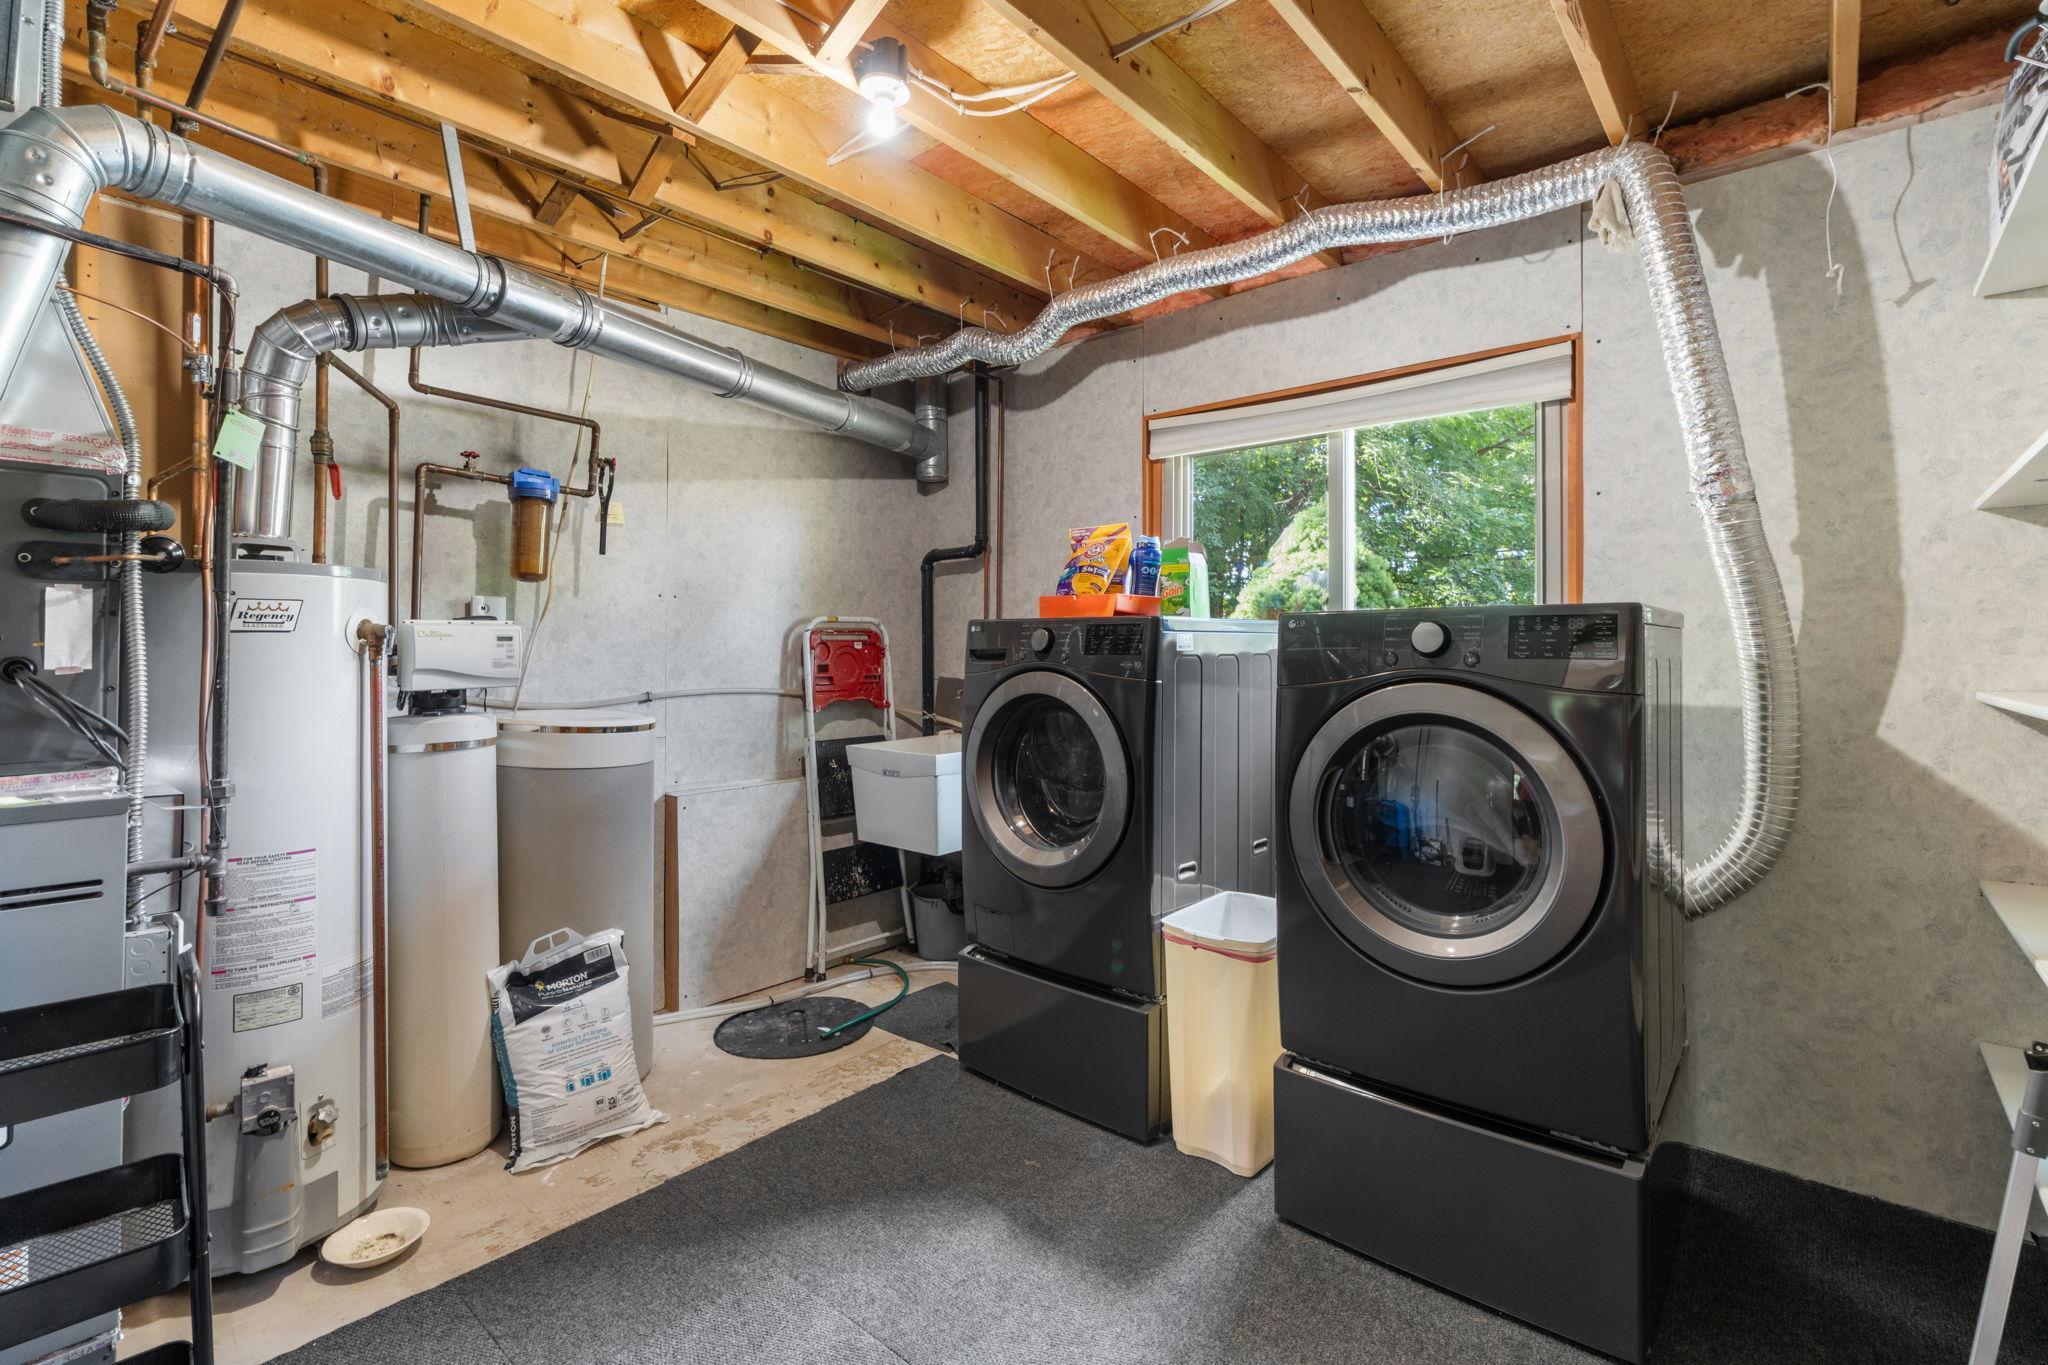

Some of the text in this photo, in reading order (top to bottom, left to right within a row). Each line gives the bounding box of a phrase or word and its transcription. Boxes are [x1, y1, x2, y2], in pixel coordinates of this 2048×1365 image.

[1162, 585, 1184, 600] Gain
[238, 611, 294, 622] Regency
[546, 971, 588, 991] MORTON
[561, 980, 593, 993] Natural
